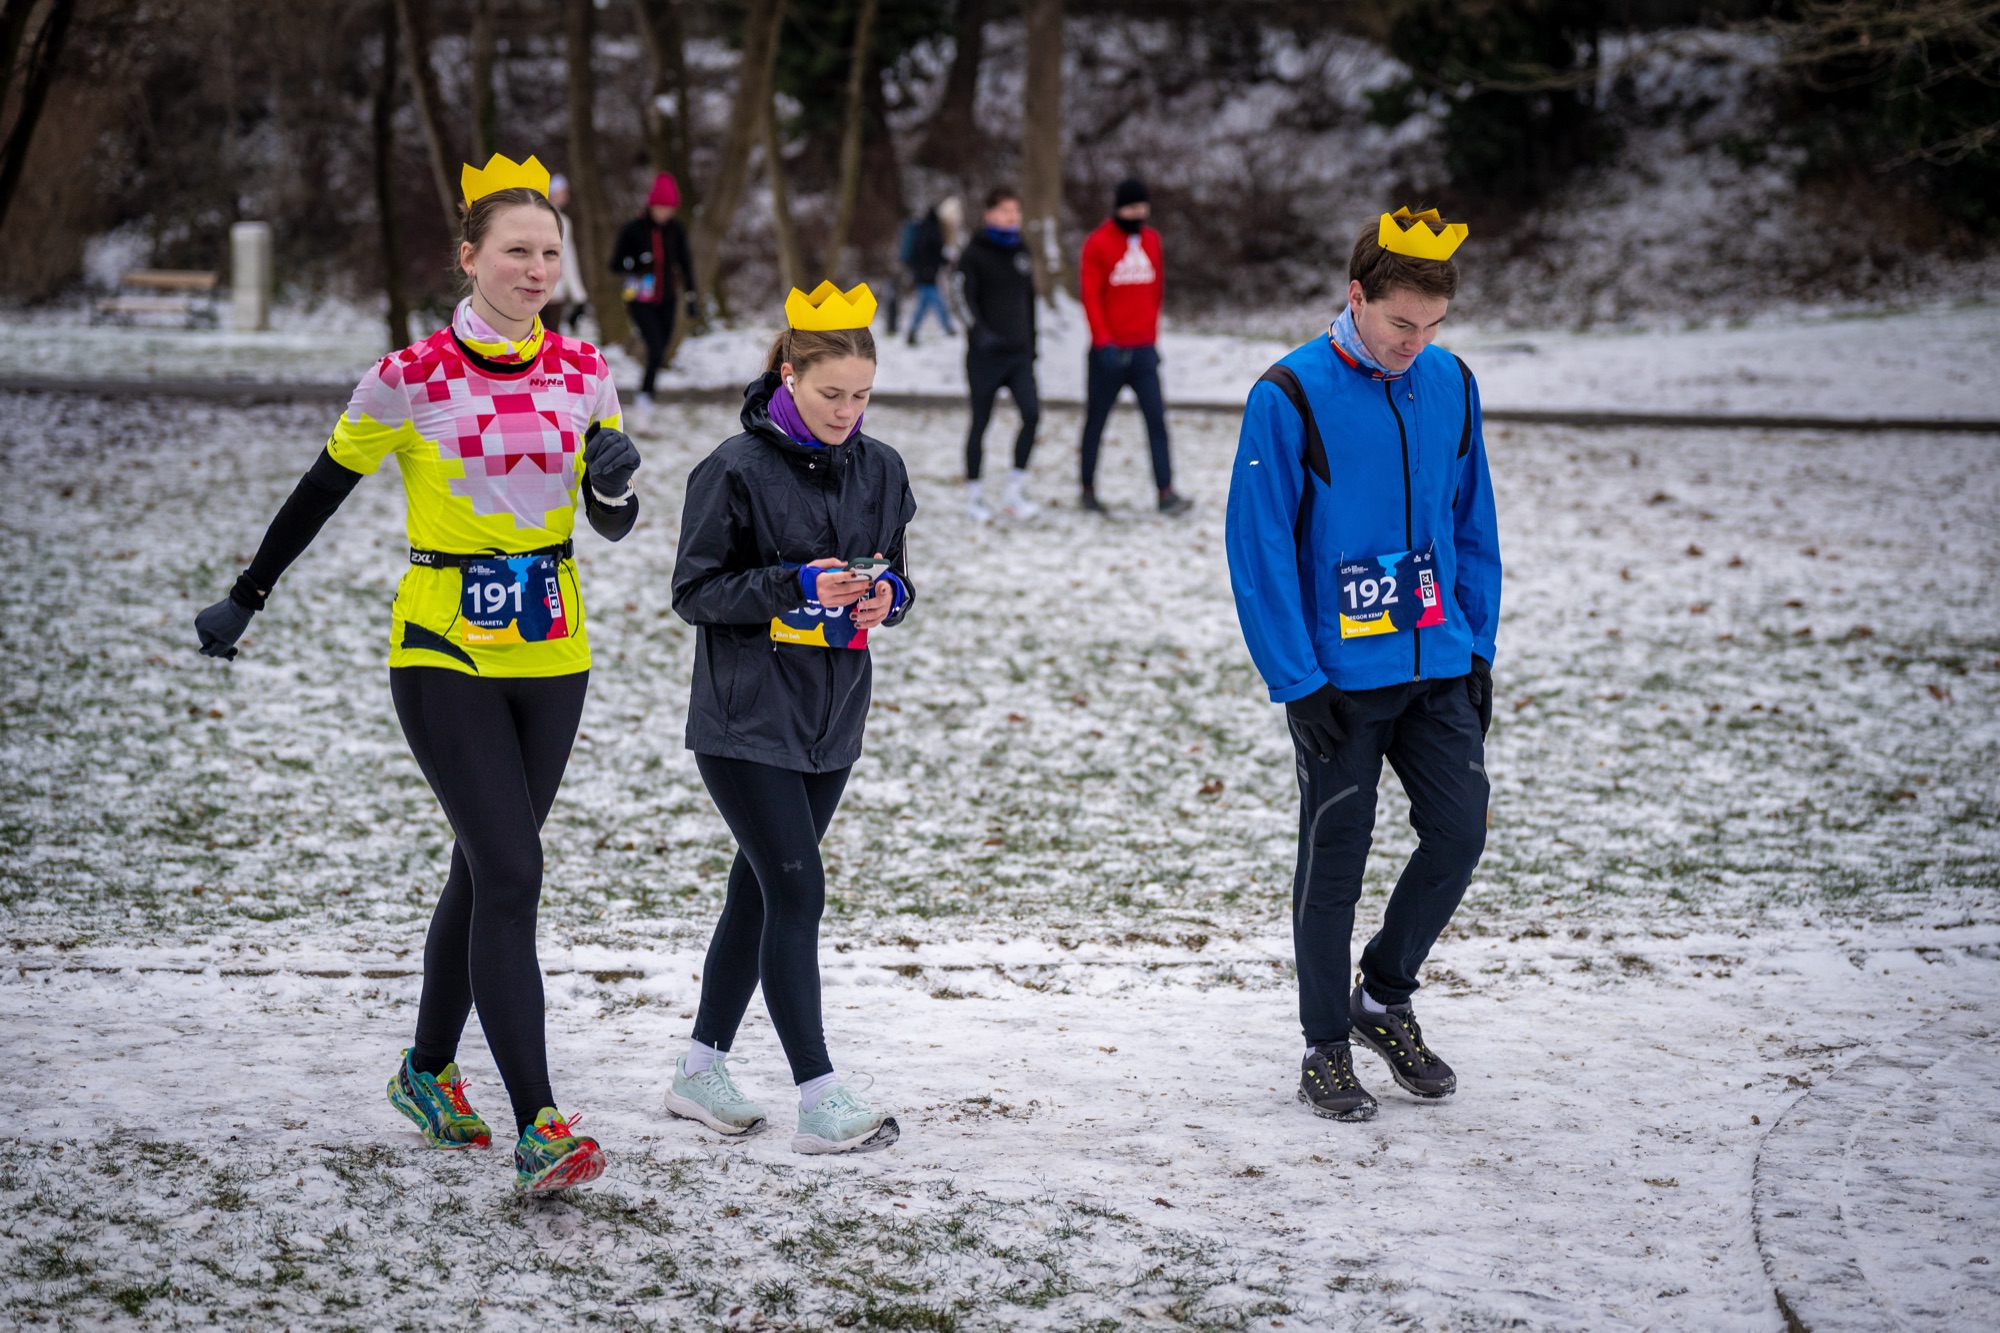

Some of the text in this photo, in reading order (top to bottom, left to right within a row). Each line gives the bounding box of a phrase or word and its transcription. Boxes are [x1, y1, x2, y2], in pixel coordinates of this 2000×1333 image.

[530, 378, 564, 387] NyNa
[467, 581, 523, 614] 191
[1343, 575, 1399, 609] 192
[467, 619, 504, 627] MARGARETA
